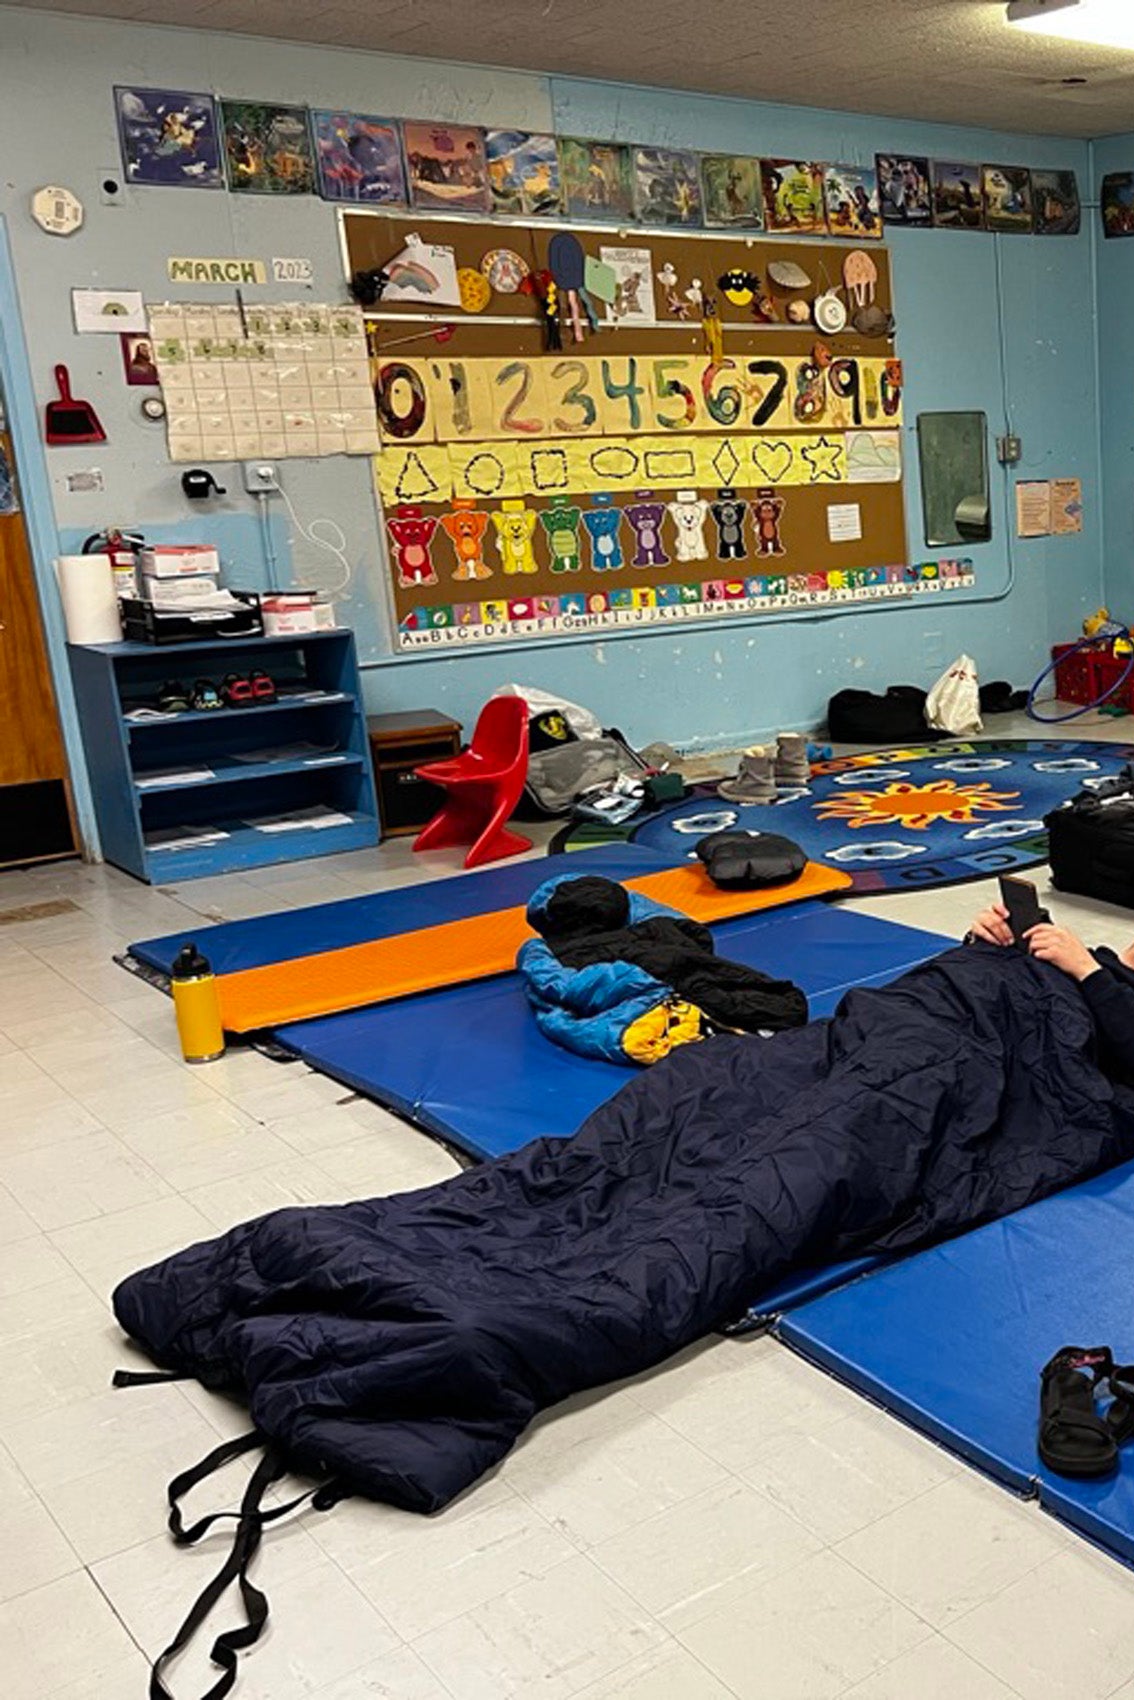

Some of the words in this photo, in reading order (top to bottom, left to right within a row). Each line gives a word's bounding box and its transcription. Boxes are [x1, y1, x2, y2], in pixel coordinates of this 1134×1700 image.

[172, 261, 257, 283] MARCH
[274, 260, 312, 280] 2023
[375, 361, 427, 438] 0
[449, 363, 473, 434] 1
[495, 361, 543, 433] 2
[551, 360, 598, 431] 3
[601, 357, 644, 429] 4
[654, 360, 697, 428] 5
[702, 358, 743, 425] 6
[747, 360, 787, 426] 7
[794, 361, 825, 424] 8
[827, 359, 861, 426] 9
[863, 366, 901, 419] 10
